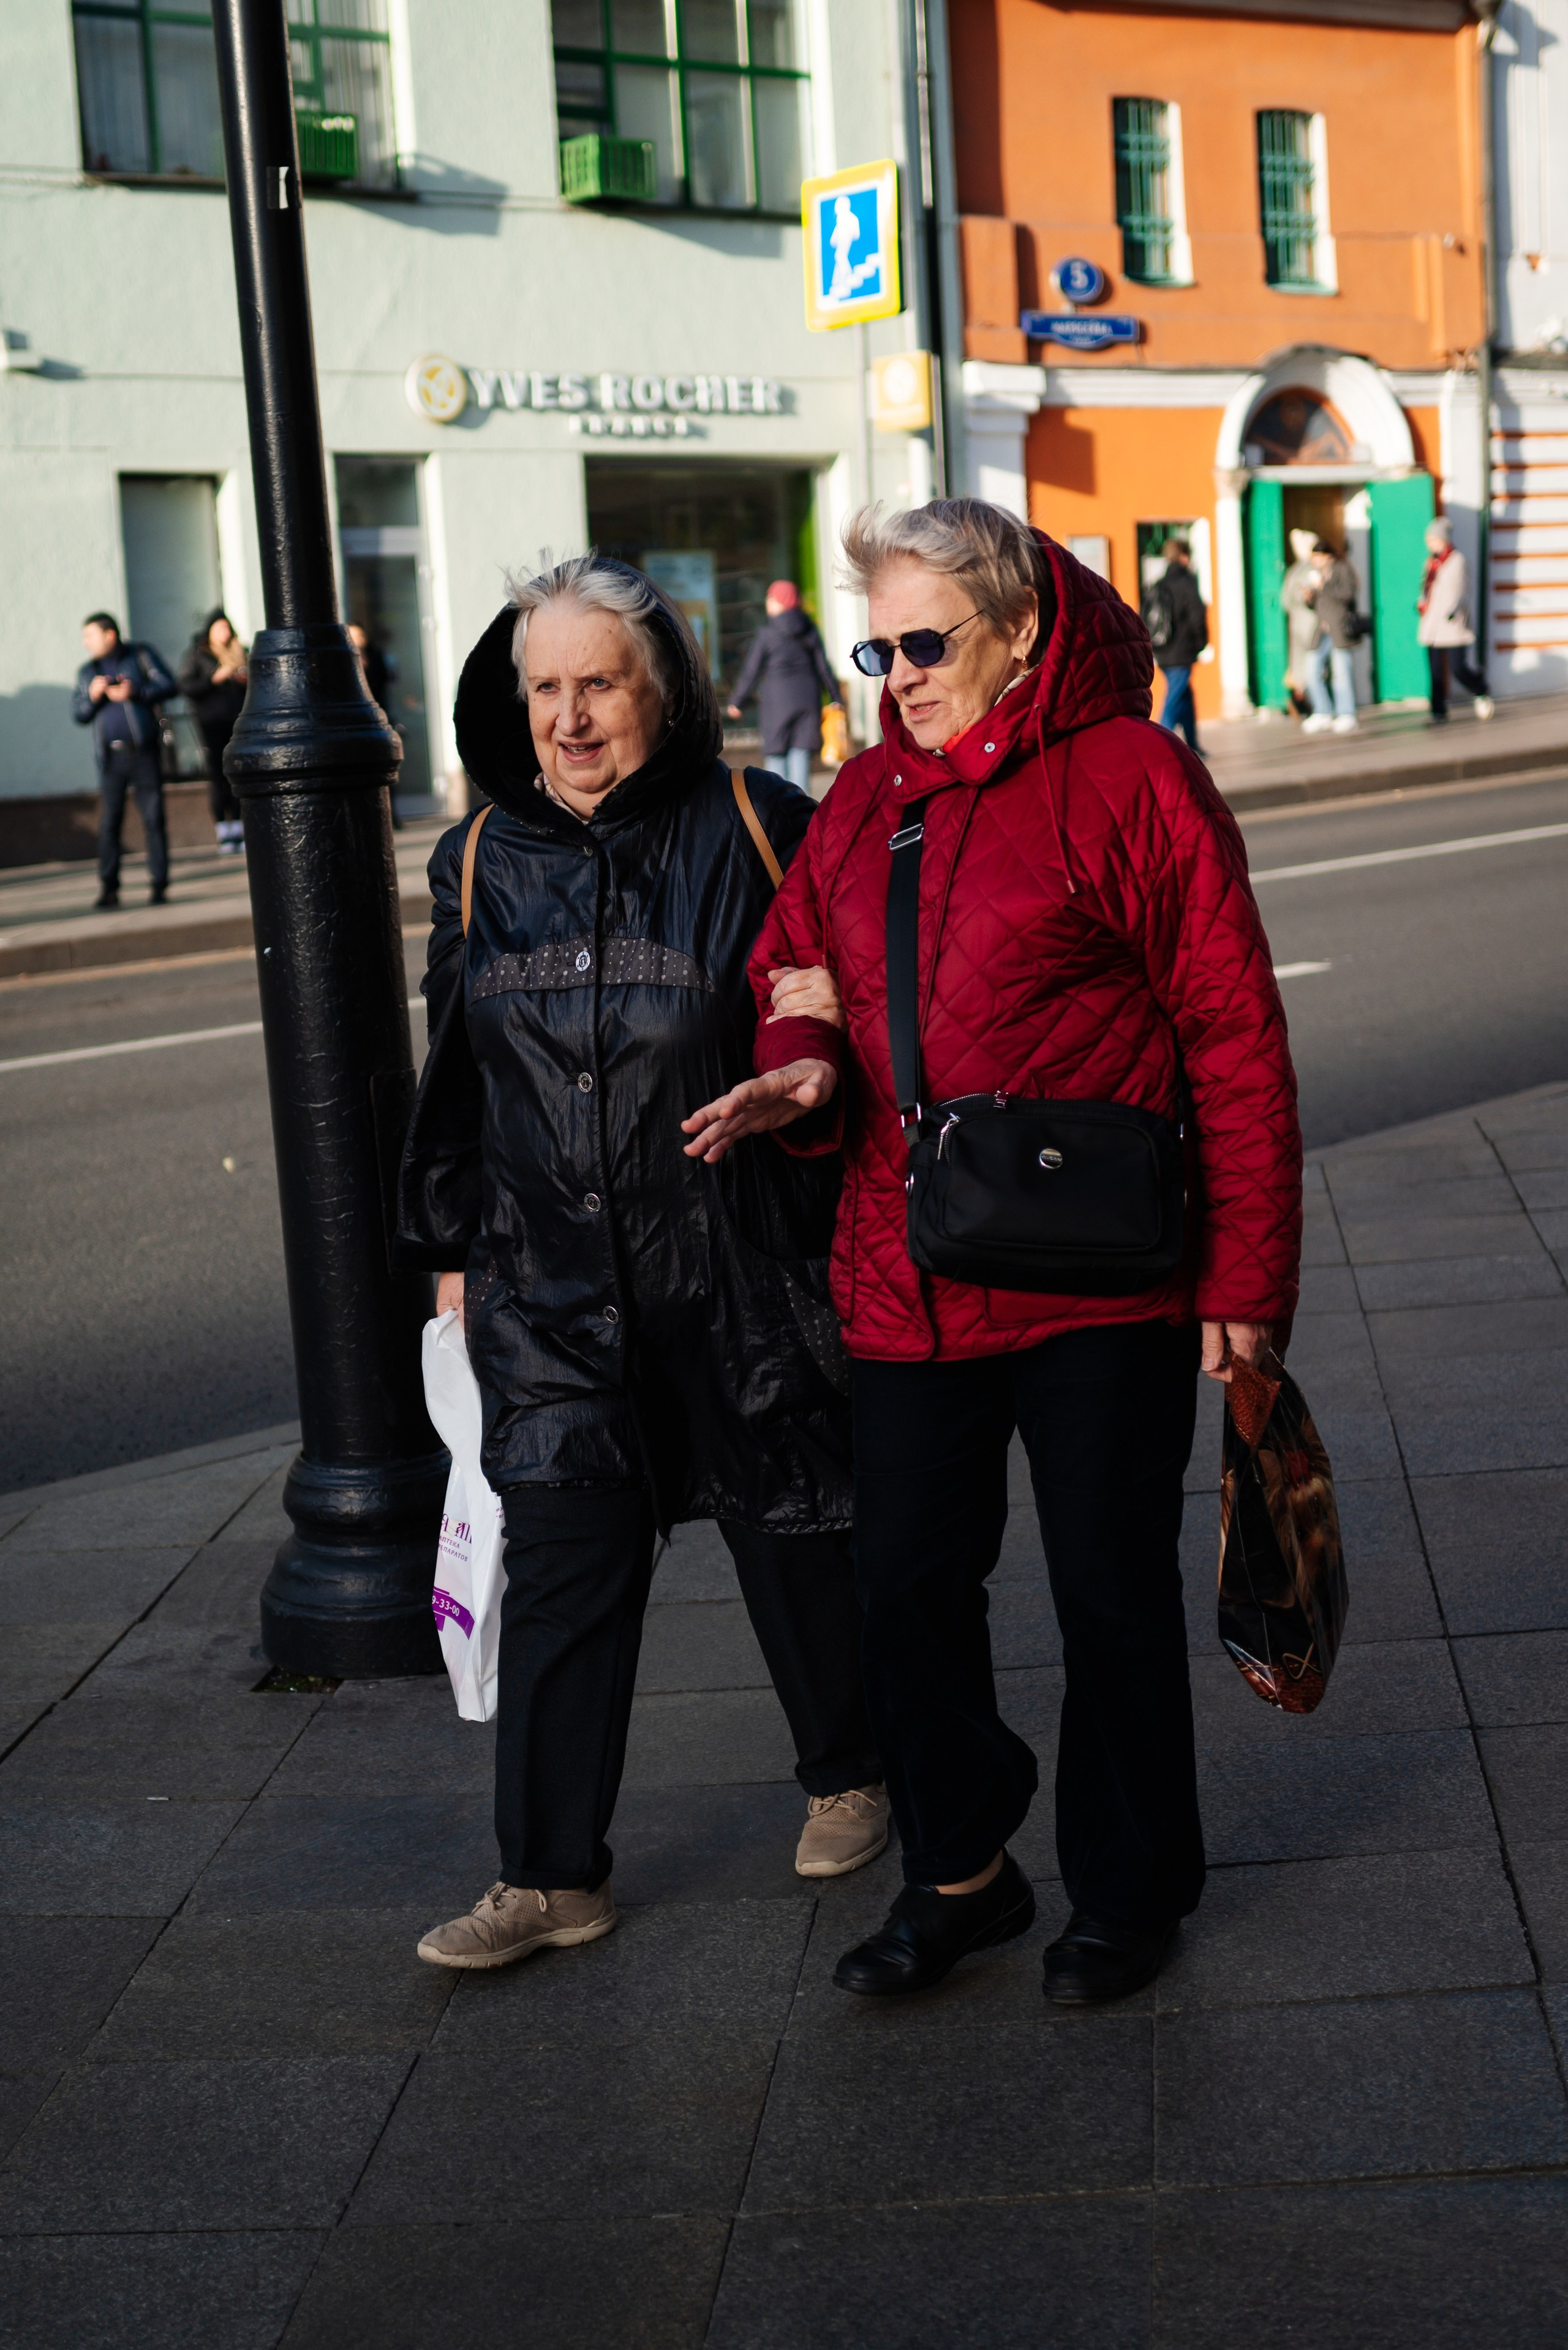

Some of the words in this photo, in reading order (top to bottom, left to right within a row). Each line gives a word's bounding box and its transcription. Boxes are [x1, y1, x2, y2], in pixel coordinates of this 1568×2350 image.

[1070, 260, 1089, 289] 5
[469, 370, 589, 409] YVES
[600, 372, 782, 412] ROCHER
[438, 1543, 468, 1562] РЕПАРАТОВ
[439, 1535, 460, 1550] АПТЕКА
